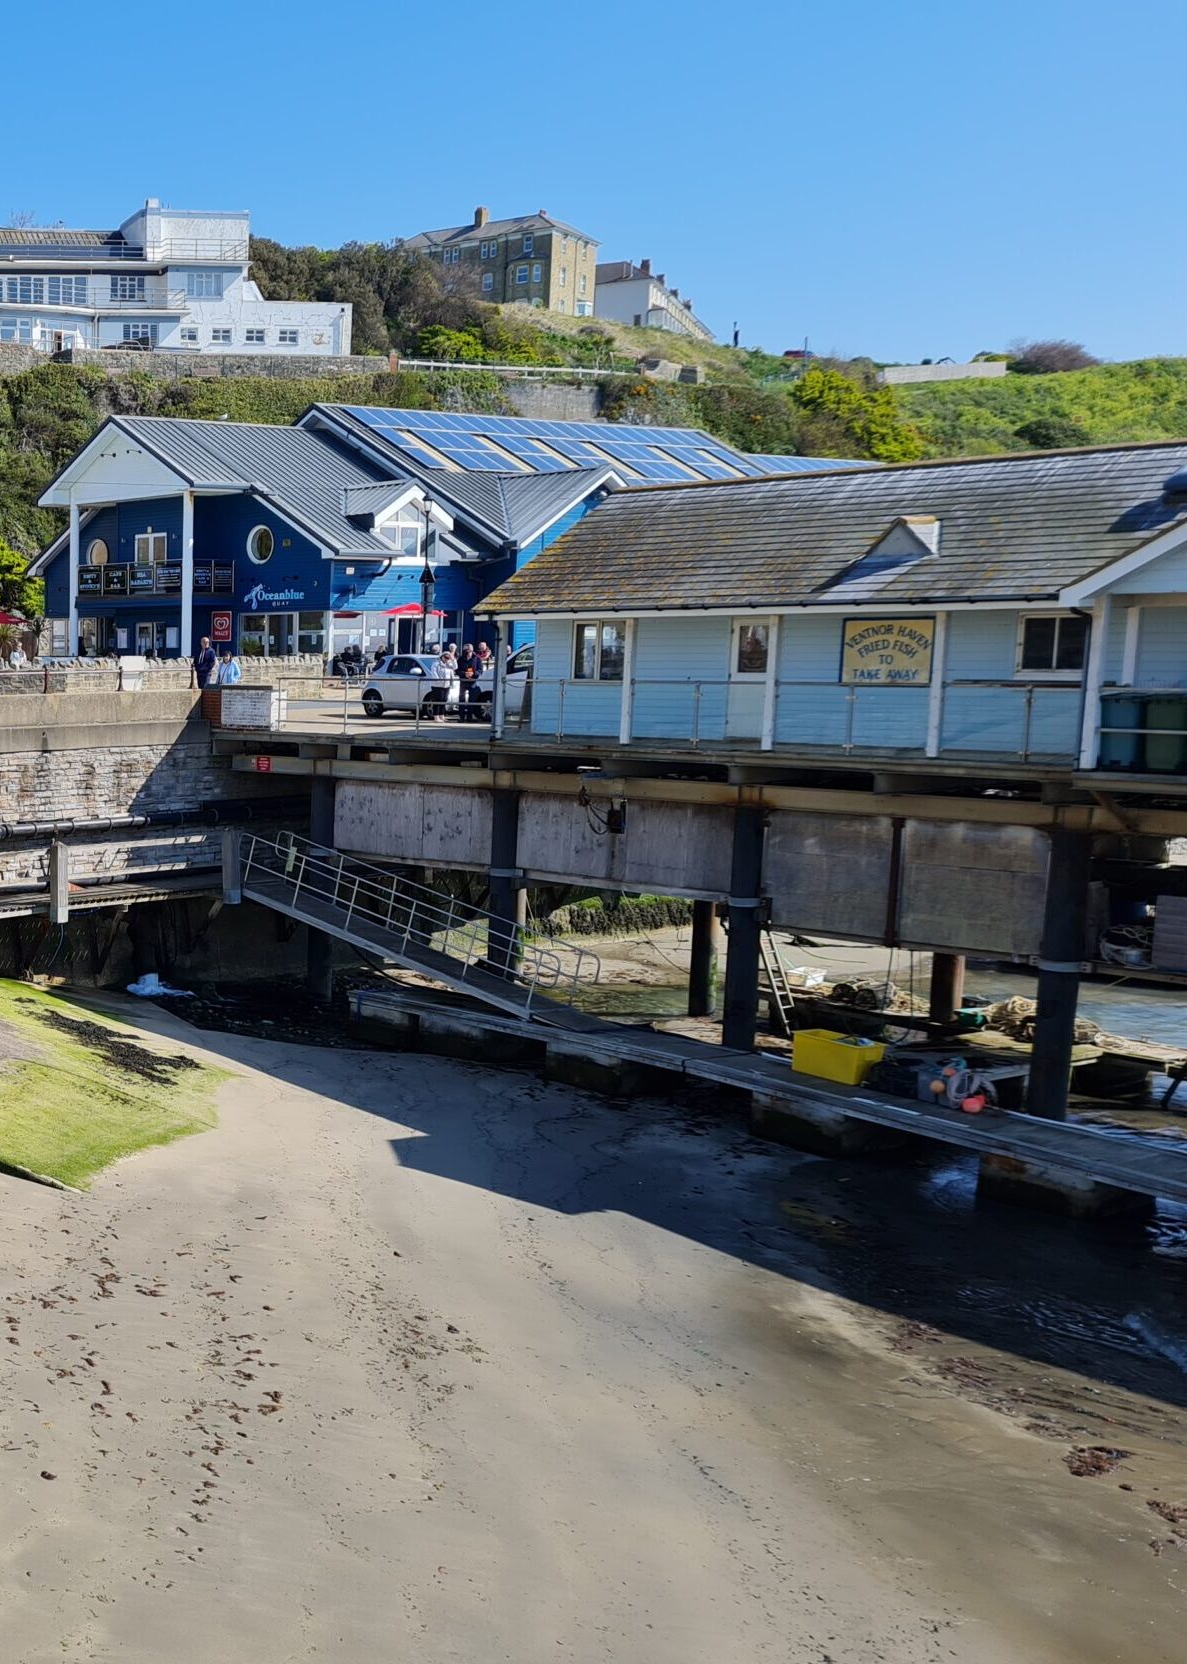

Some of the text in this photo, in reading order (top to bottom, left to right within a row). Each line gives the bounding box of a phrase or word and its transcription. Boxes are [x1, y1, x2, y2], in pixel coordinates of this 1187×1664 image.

[257, 589, 304, 601] Oceanblue
[845, 624, 932, 650] VENTNOR HAVEN
[857, 639, 919, 659] FRIED FISH
[878, 654, 893, 665] TO
[852, 669, 918, 680] TAKE AWAY
